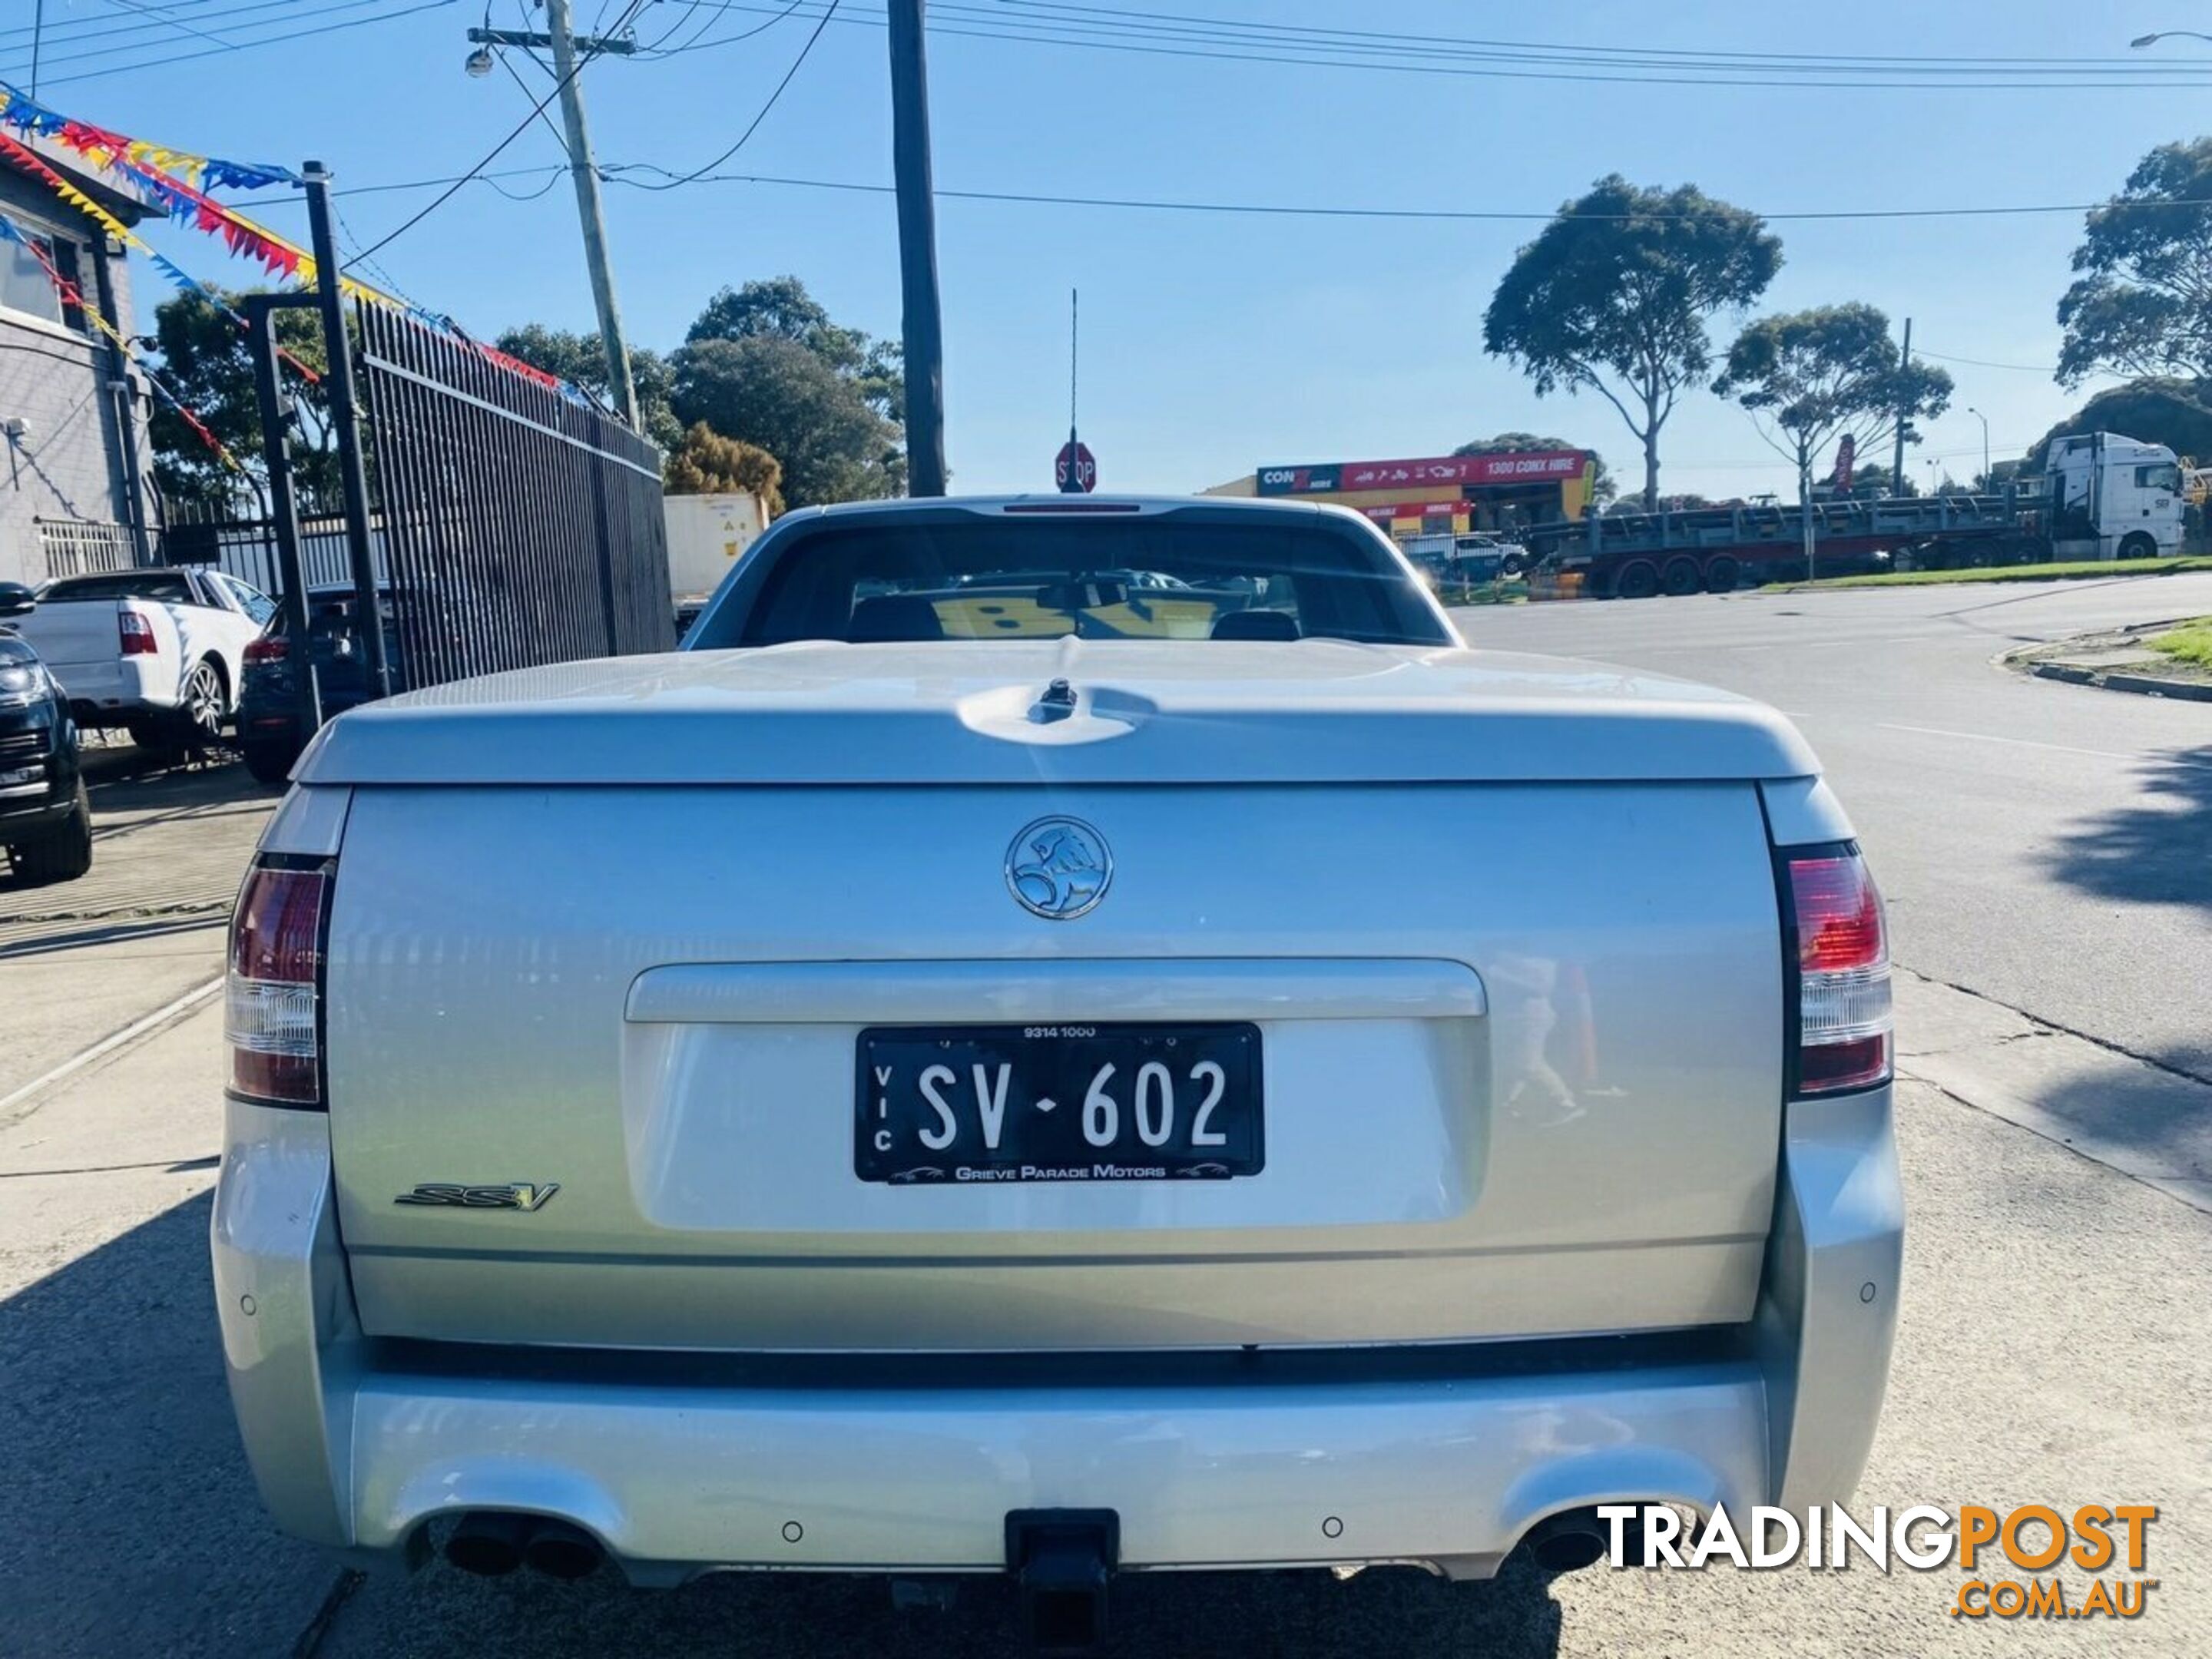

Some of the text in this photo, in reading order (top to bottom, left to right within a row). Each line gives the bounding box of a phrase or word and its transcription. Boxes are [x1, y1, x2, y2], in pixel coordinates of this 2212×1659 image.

[1059, 461, 1093, 483] SOP
[1488, 457, 1575, 475] 1300 CONX HIRE
[1024, 1026, 1096, 1038] 9314 1000
[874, 1065, 892, 1151] VIC
